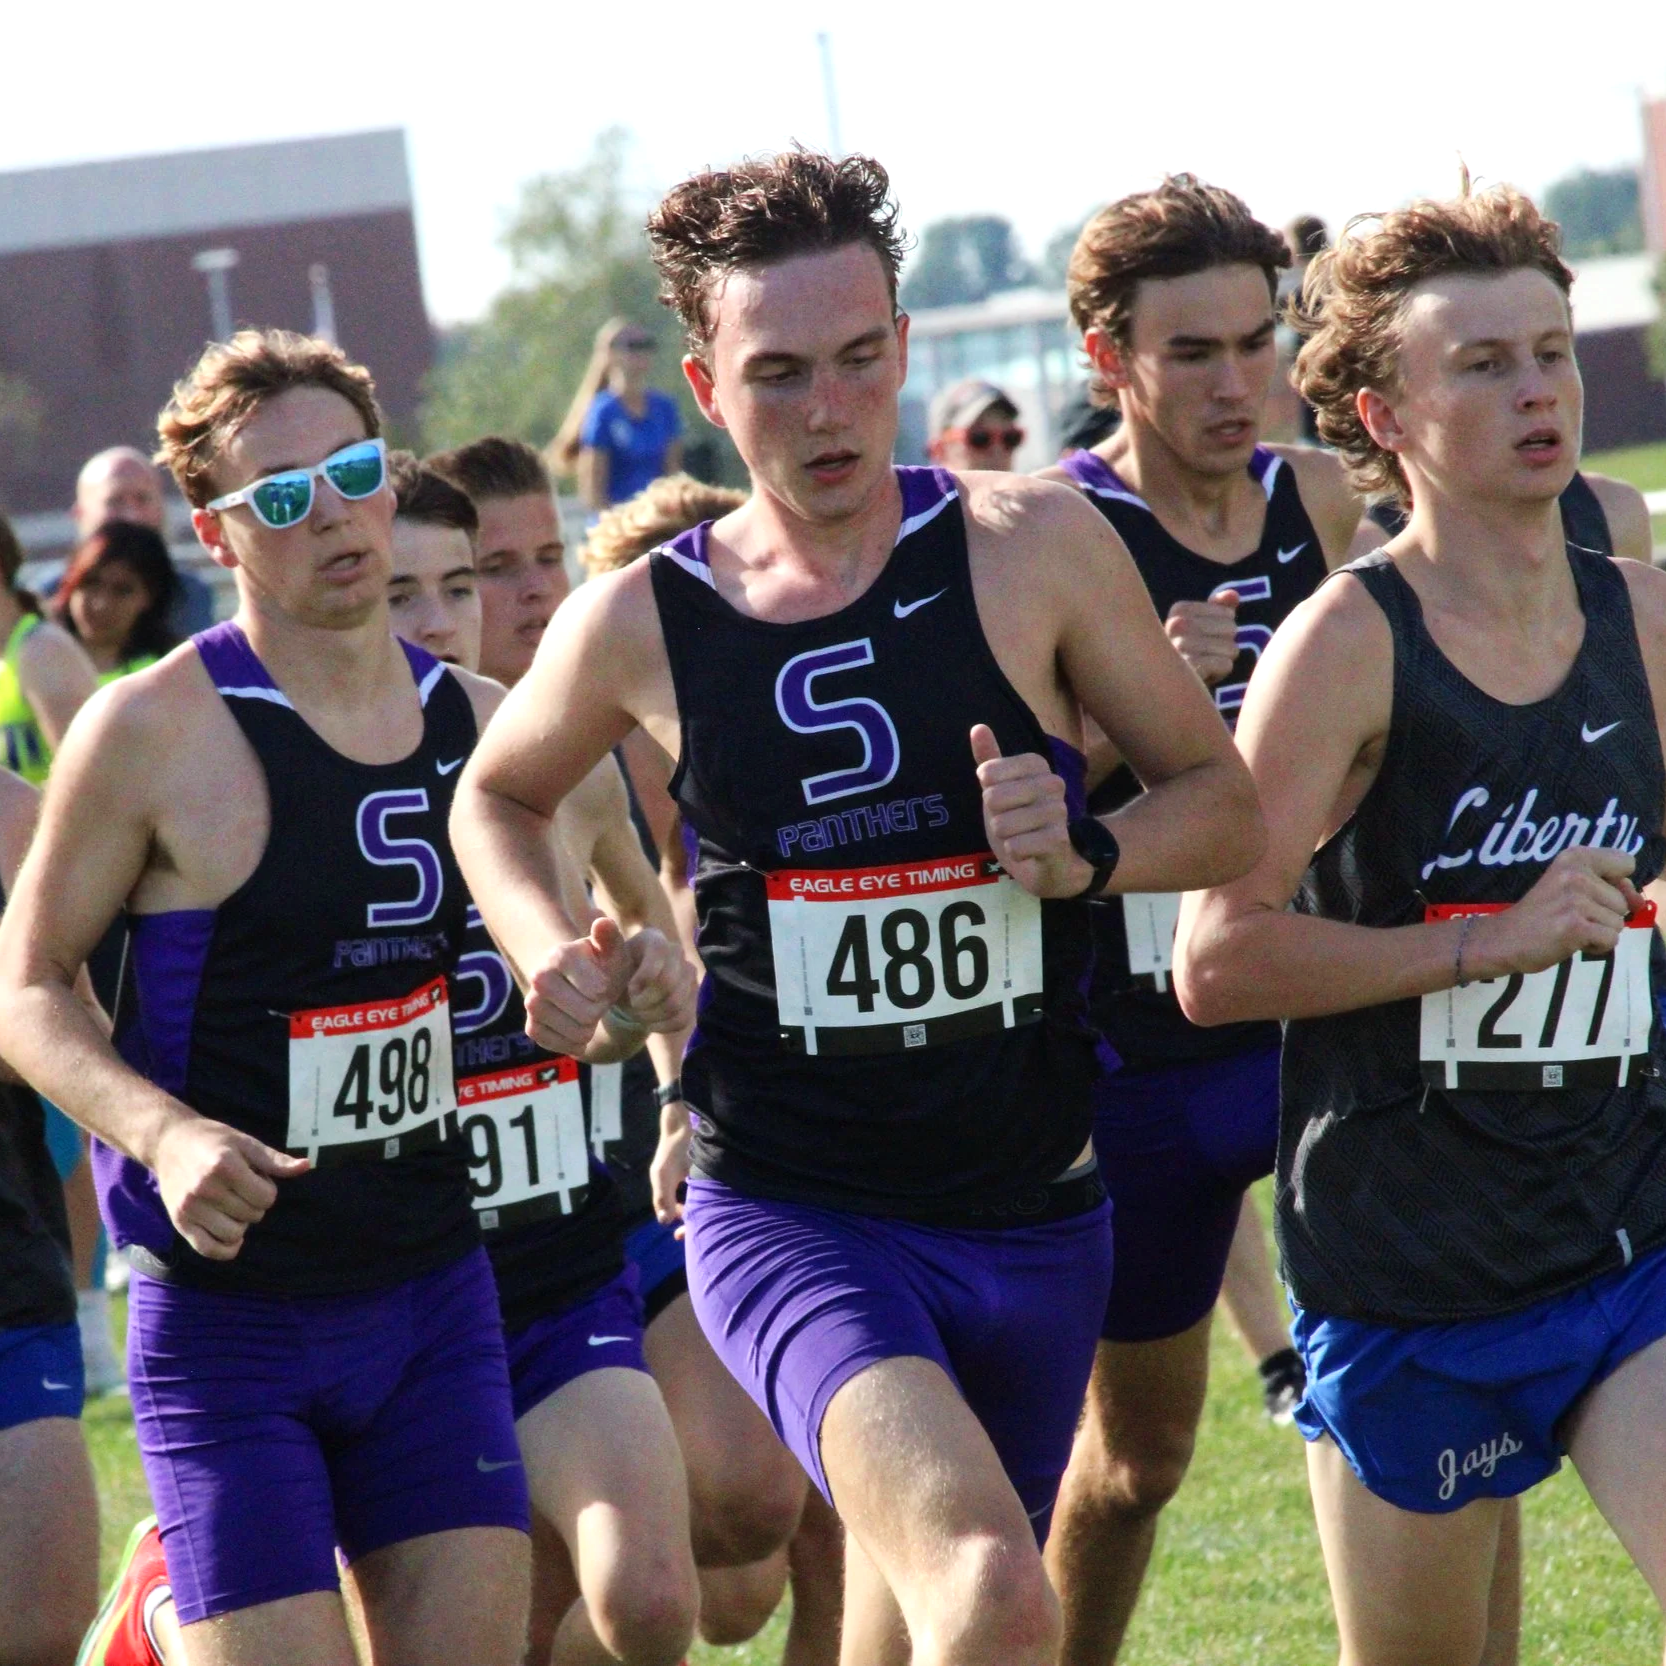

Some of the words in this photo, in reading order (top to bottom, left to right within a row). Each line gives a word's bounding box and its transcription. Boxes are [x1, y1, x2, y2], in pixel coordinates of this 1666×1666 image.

[775, 637, 900, 806] S
[355, 788, 444, 928] S
[789, 877, 854, 893] EAGLE
[859, 873, 901, 891] EYE
[905, 863, 976, 886] TIMING
[1421, 787, 1645, 880] Liberty
[826, 901, 989, 1013] 486
[1477, 948, 1617, 1049] 277
[311, 1011, 364, 1031] EAGLE
[366, 1007, 398, 1023] EYE
[333, 1026, 432, 1130] 498
[478, 1072, 533, 1095] TIMING
[1438, 1432, 1523, 1500] Jays
